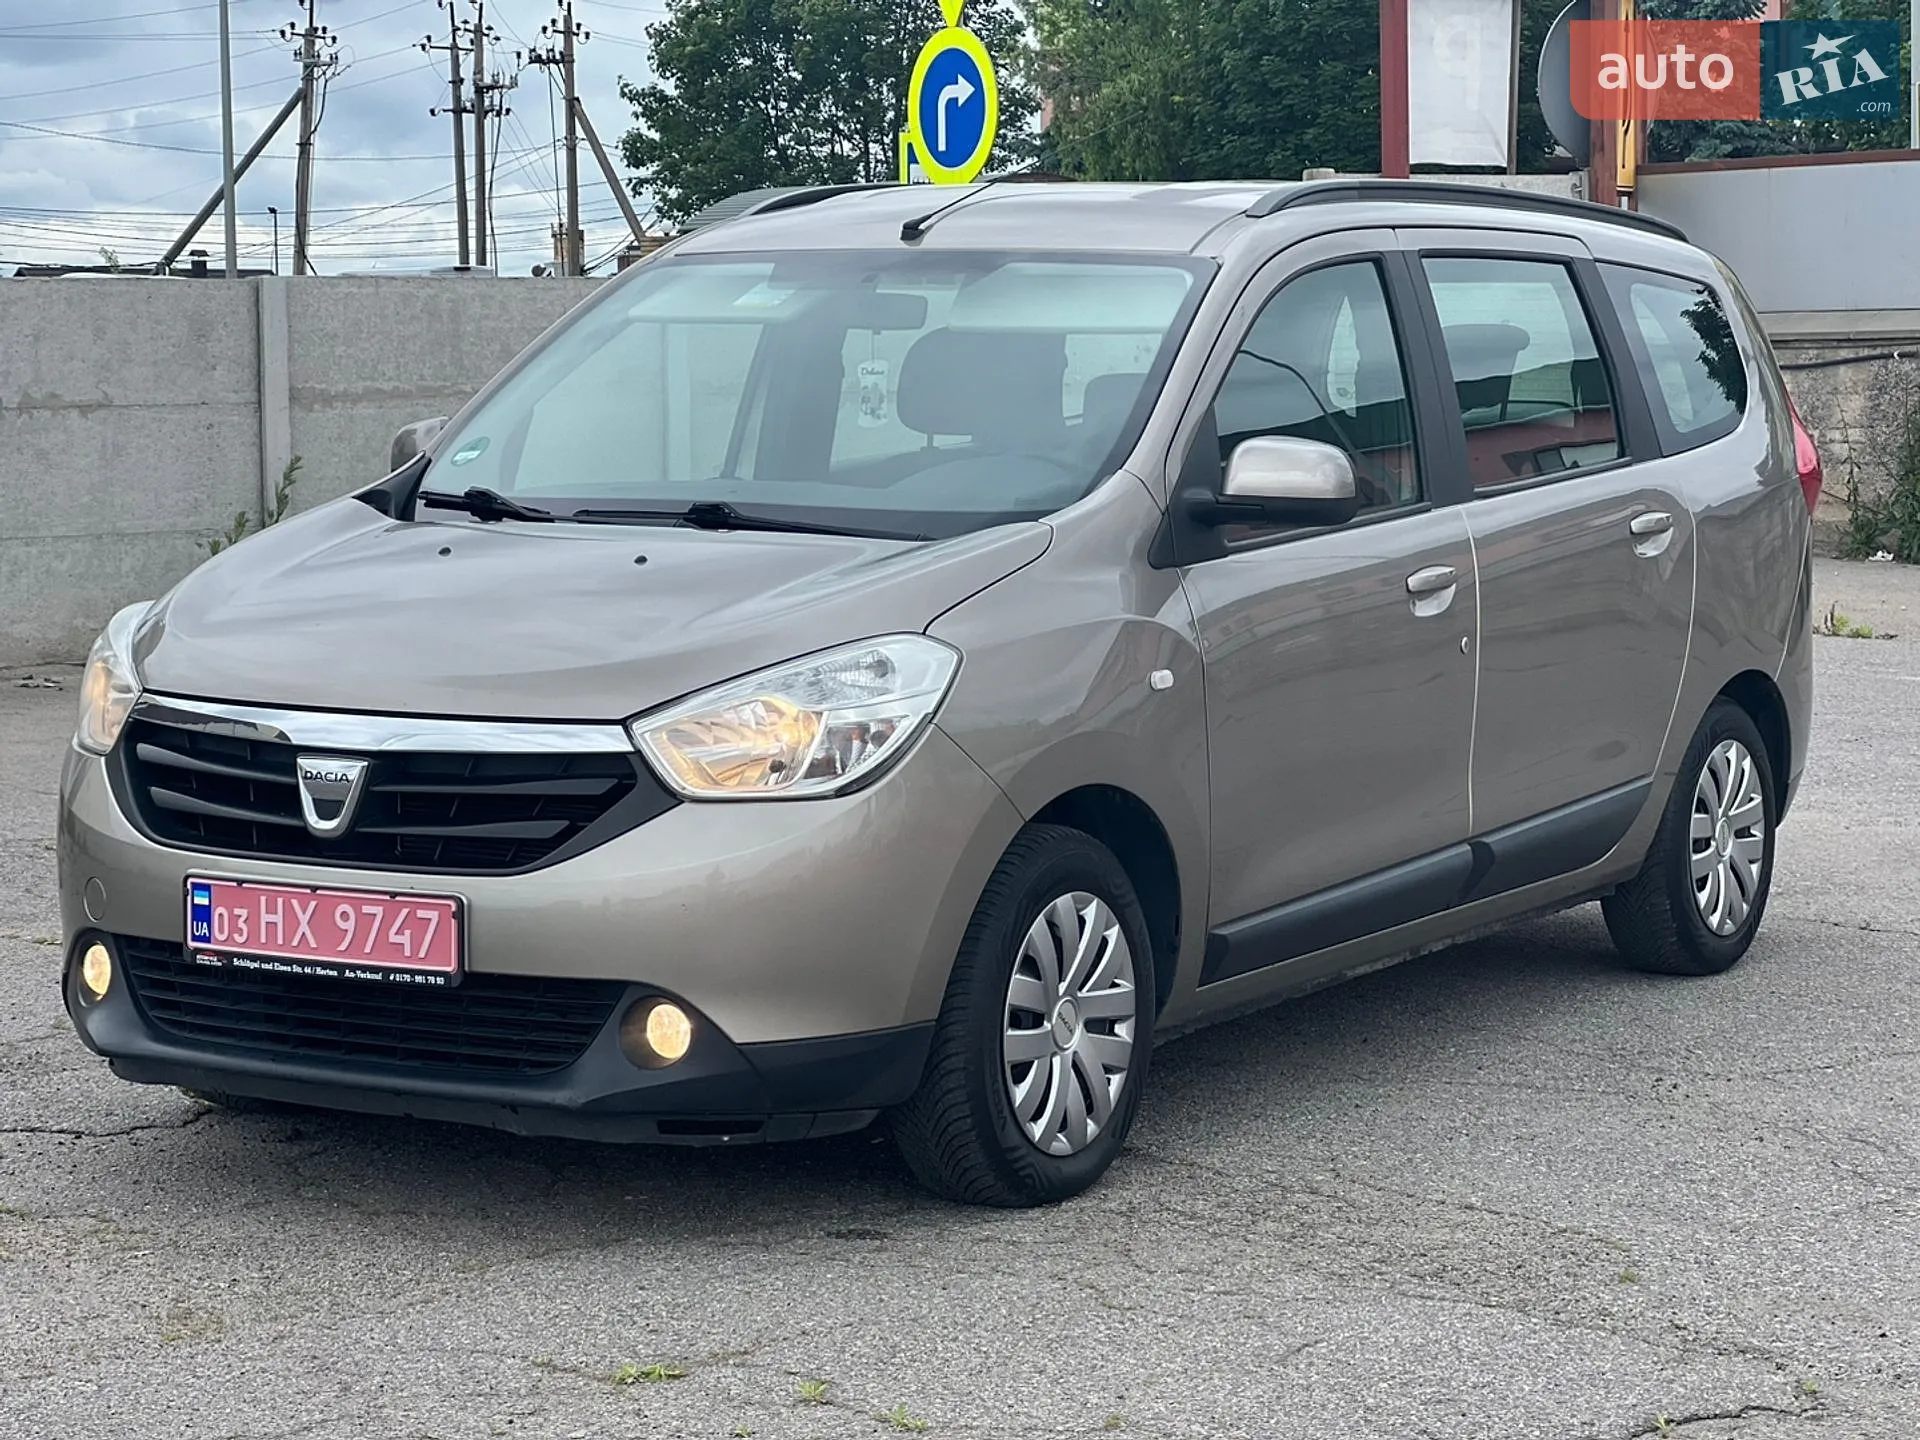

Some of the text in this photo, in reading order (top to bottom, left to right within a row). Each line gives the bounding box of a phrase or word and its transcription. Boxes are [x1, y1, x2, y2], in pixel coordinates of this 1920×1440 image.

[303, 770, 350, 783] DACIA
[193, 920, 210, 937] UA
[213, 895, 440, 959] 03 HX 9747
